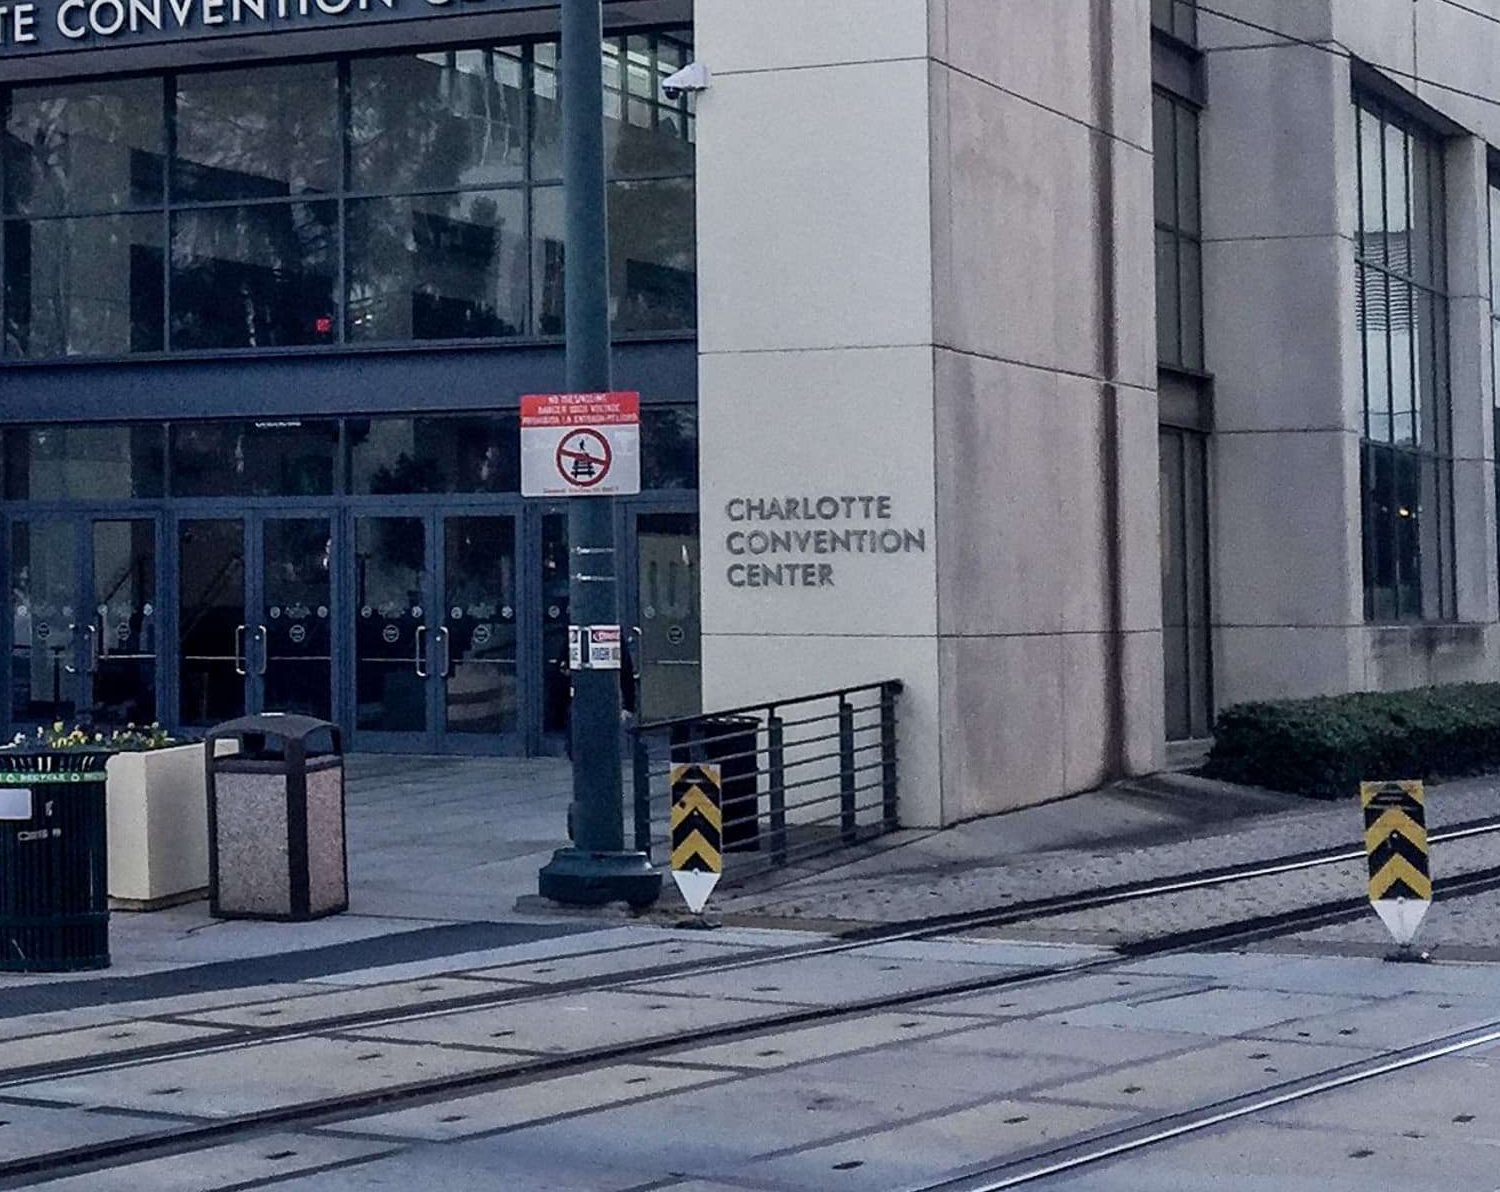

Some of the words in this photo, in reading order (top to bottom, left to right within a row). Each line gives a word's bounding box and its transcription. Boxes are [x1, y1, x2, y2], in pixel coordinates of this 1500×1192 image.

[725, 495, 892, 521] CHARLOTTE
[726, 528, 925, 555] CONVENTION
[726, 563, 835, 587] CENTER
